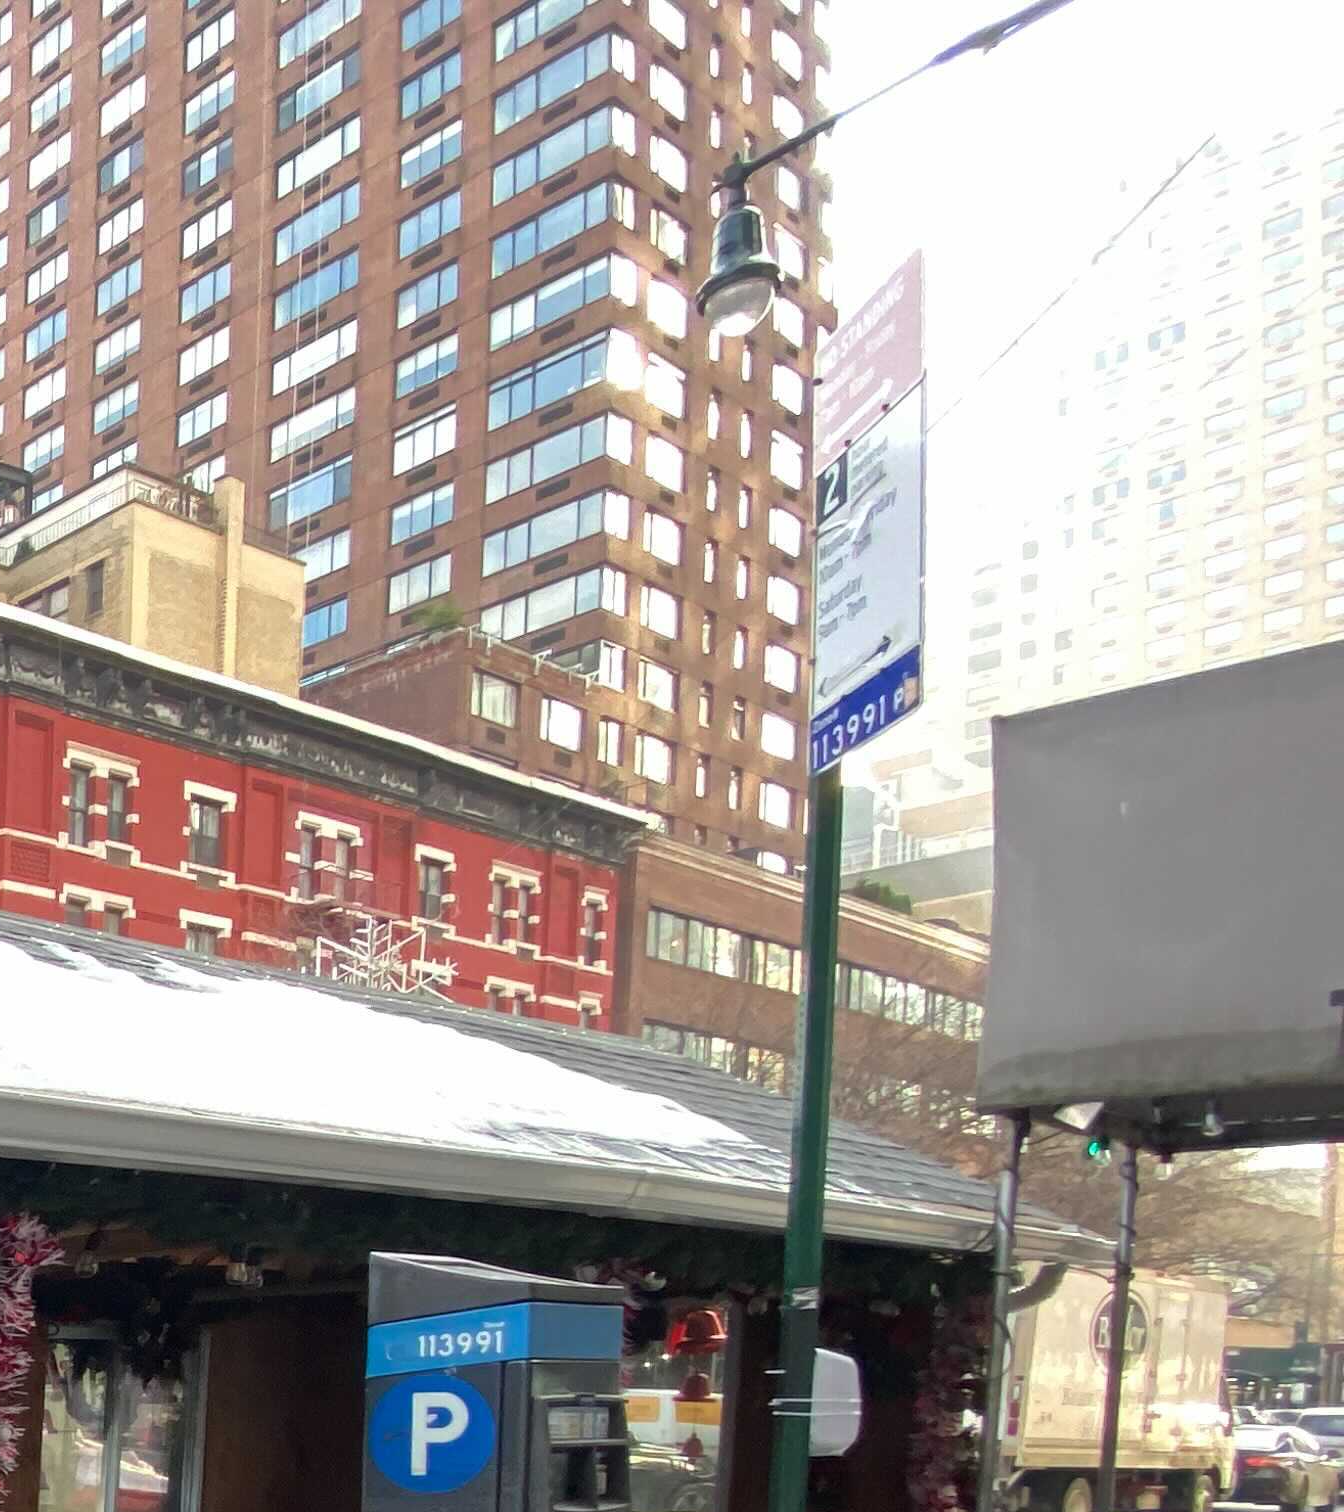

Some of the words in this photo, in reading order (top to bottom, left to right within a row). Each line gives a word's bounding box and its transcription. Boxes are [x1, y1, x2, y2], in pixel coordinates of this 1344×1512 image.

[823, 461, 840, 517] 2
[813, 694, 886, 769] 113991
[418, 1330, 504, 1357] 113991
[410, 1391, 469, 1476] P
